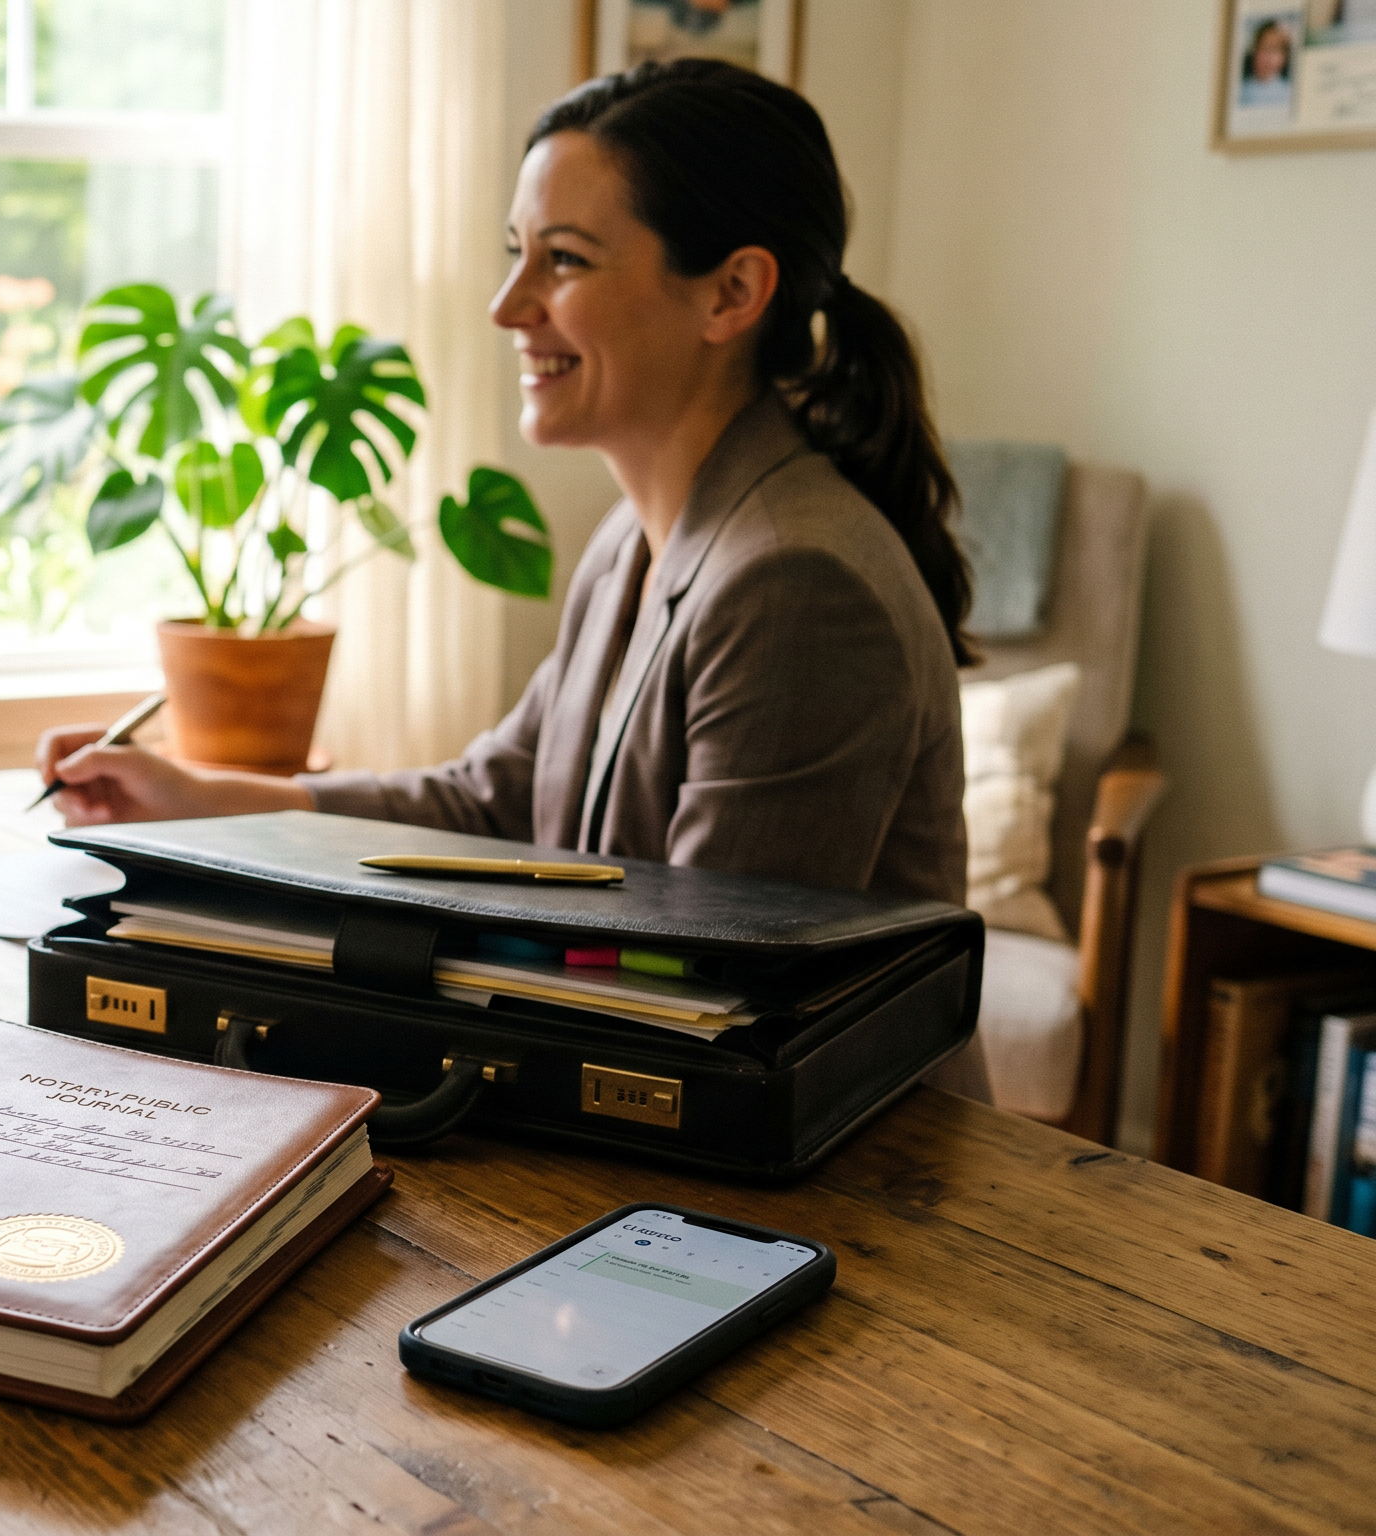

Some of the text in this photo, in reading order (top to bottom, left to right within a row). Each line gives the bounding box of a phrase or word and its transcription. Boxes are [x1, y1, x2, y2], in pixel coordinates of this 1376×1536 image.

[20, 1074, 212, 1115] NOTARY PUBLIC
[45, 1092, 157, 1120] JOURNAL
